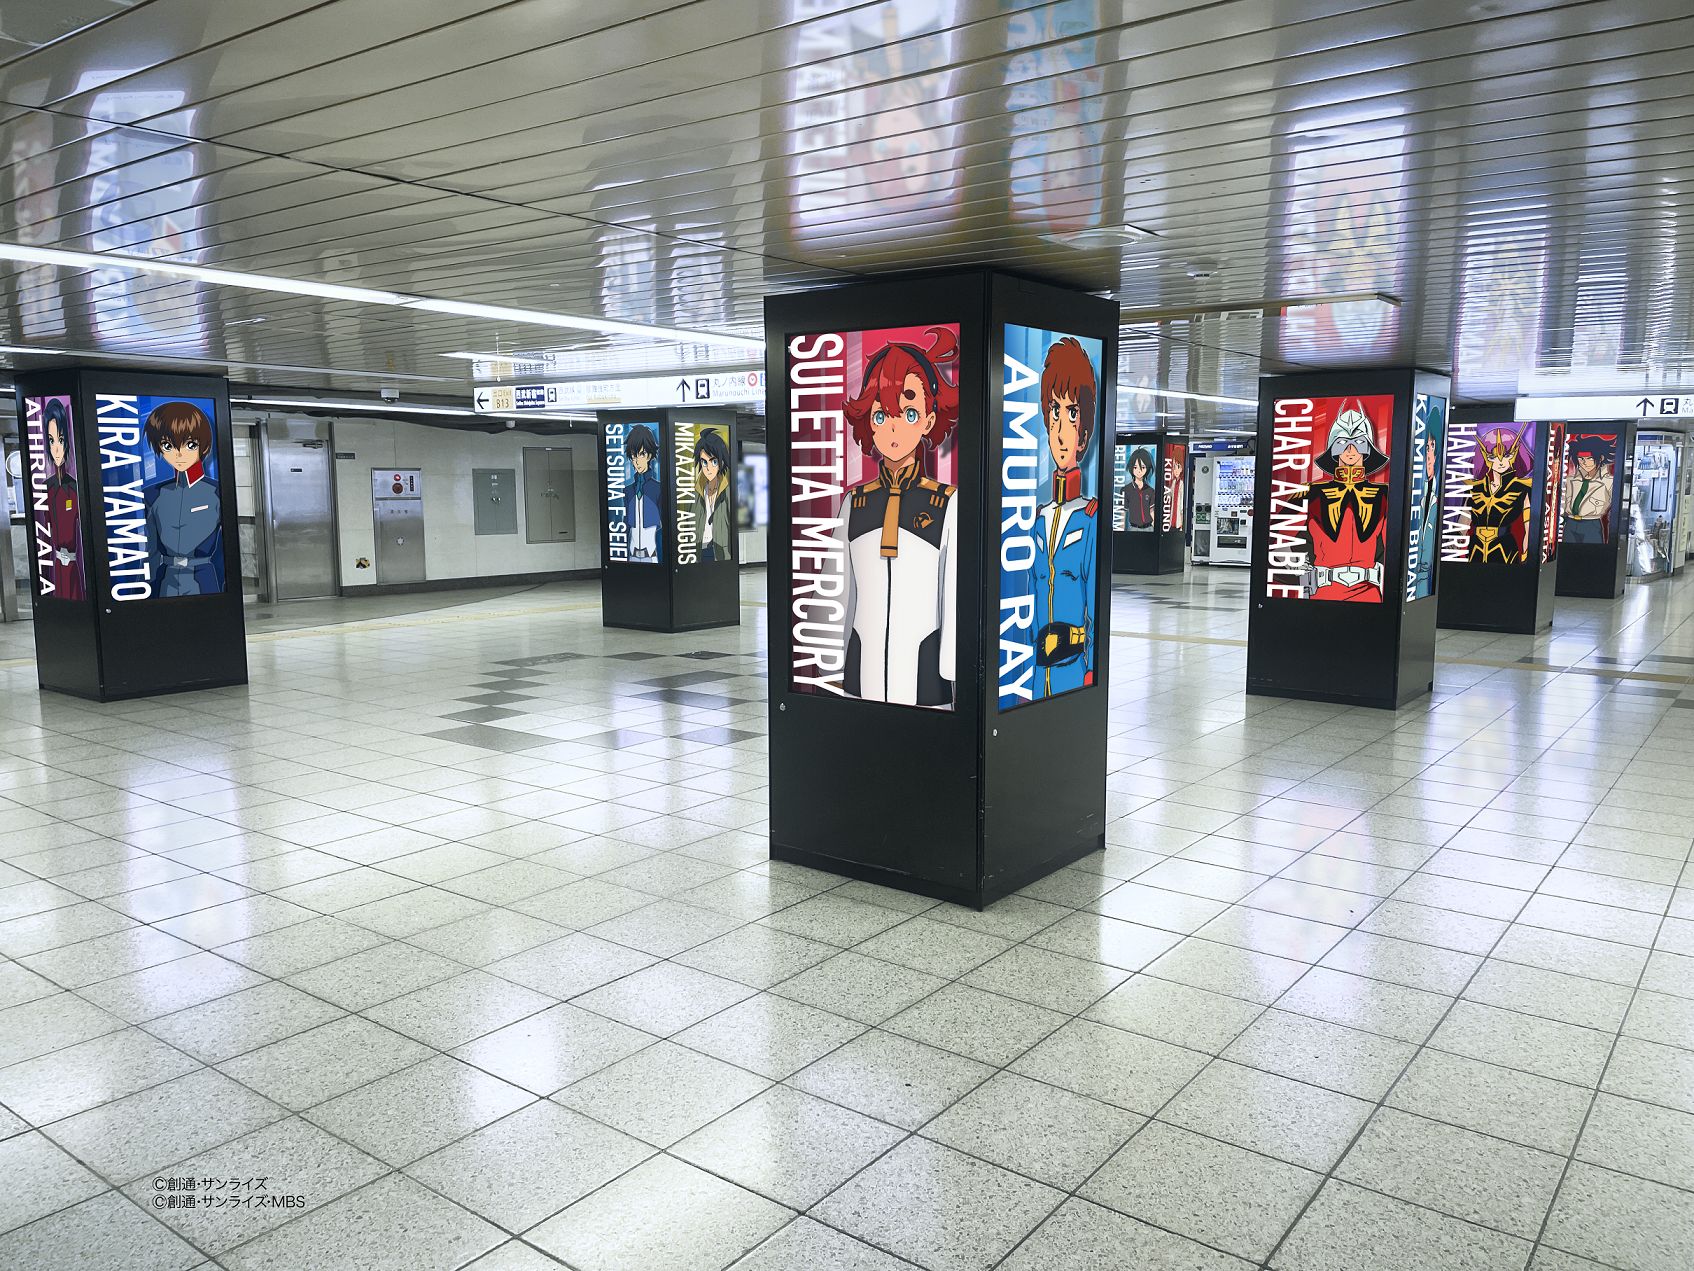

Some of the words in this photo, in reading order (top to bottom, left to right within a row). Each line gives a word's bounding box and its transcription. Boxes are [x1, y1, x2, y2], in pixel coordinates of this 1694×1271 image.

[25, 398, 49, 511] ATHRUN
[95, 394, 142, 469] KIRA
[789, 333, 845, 503] SULETTA
[1271, 398, 1314, 471] CHAR
[605, 423, 626, 501] SETSUNA
[674, 422, 696, 504] MIKAZUKI
[1000, 353, 1040, 573] AMURO
[1163, 458, 1173, 481] KIO
[1410, 394, 1428, 520] KAMILLE
[1444, 423, 1477, 498] HAMAN
[102, 478, 152, 601] YAMATO
[608, 506, 627, 517] F
[608, 521, 628, 562] SEIEI
[676, 510, 697, 565] AUGUS
[1162, 485, 1172, 532] ASUNO
[1266, 480, 1310, 600] AZNABLE
[1441, 505, 1473, 563] KARN
[34, 522, 56, 596] ZALA
[1406, 529, 1420, 603] BIDAN
[791, 517, 845, 696] MERCURY
[998, 594, 1035, 701] RAY
